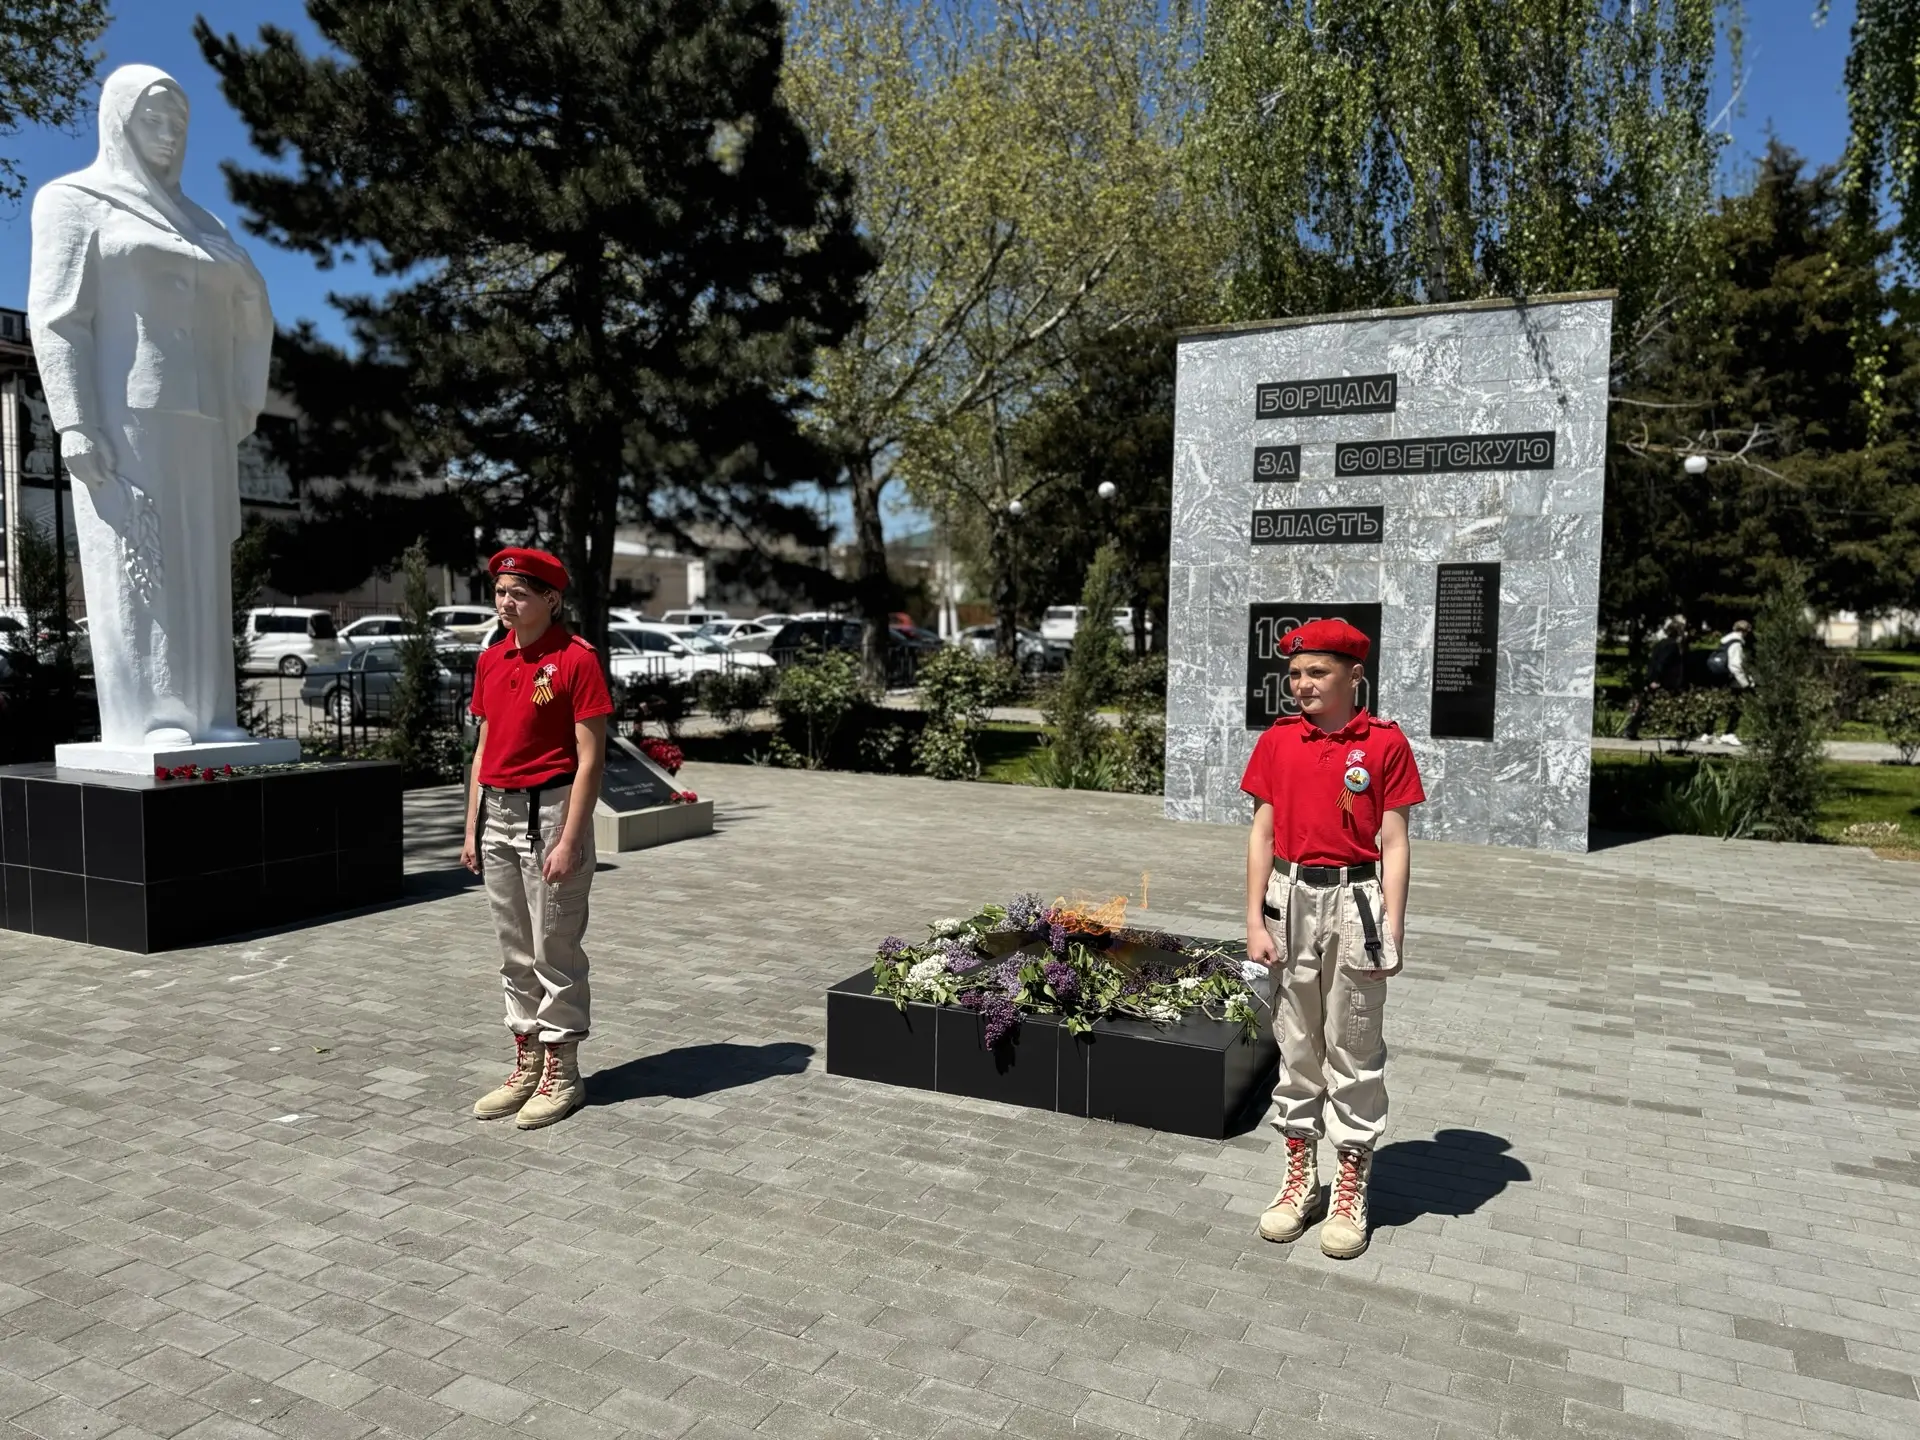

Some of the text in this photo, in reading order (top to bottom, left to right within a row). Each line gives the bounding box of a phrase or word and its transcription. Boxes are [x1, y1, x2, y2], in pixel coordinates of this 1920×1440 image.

[1259, 380, 1392, 412] БОРЦАМ
[1257, 438, 1550, 475] ЗА СОВЕТСКУЮ
[1254, 512, 1379, 538] ВЛАСТЬ
[1256, 617, 1350, 659] 19
